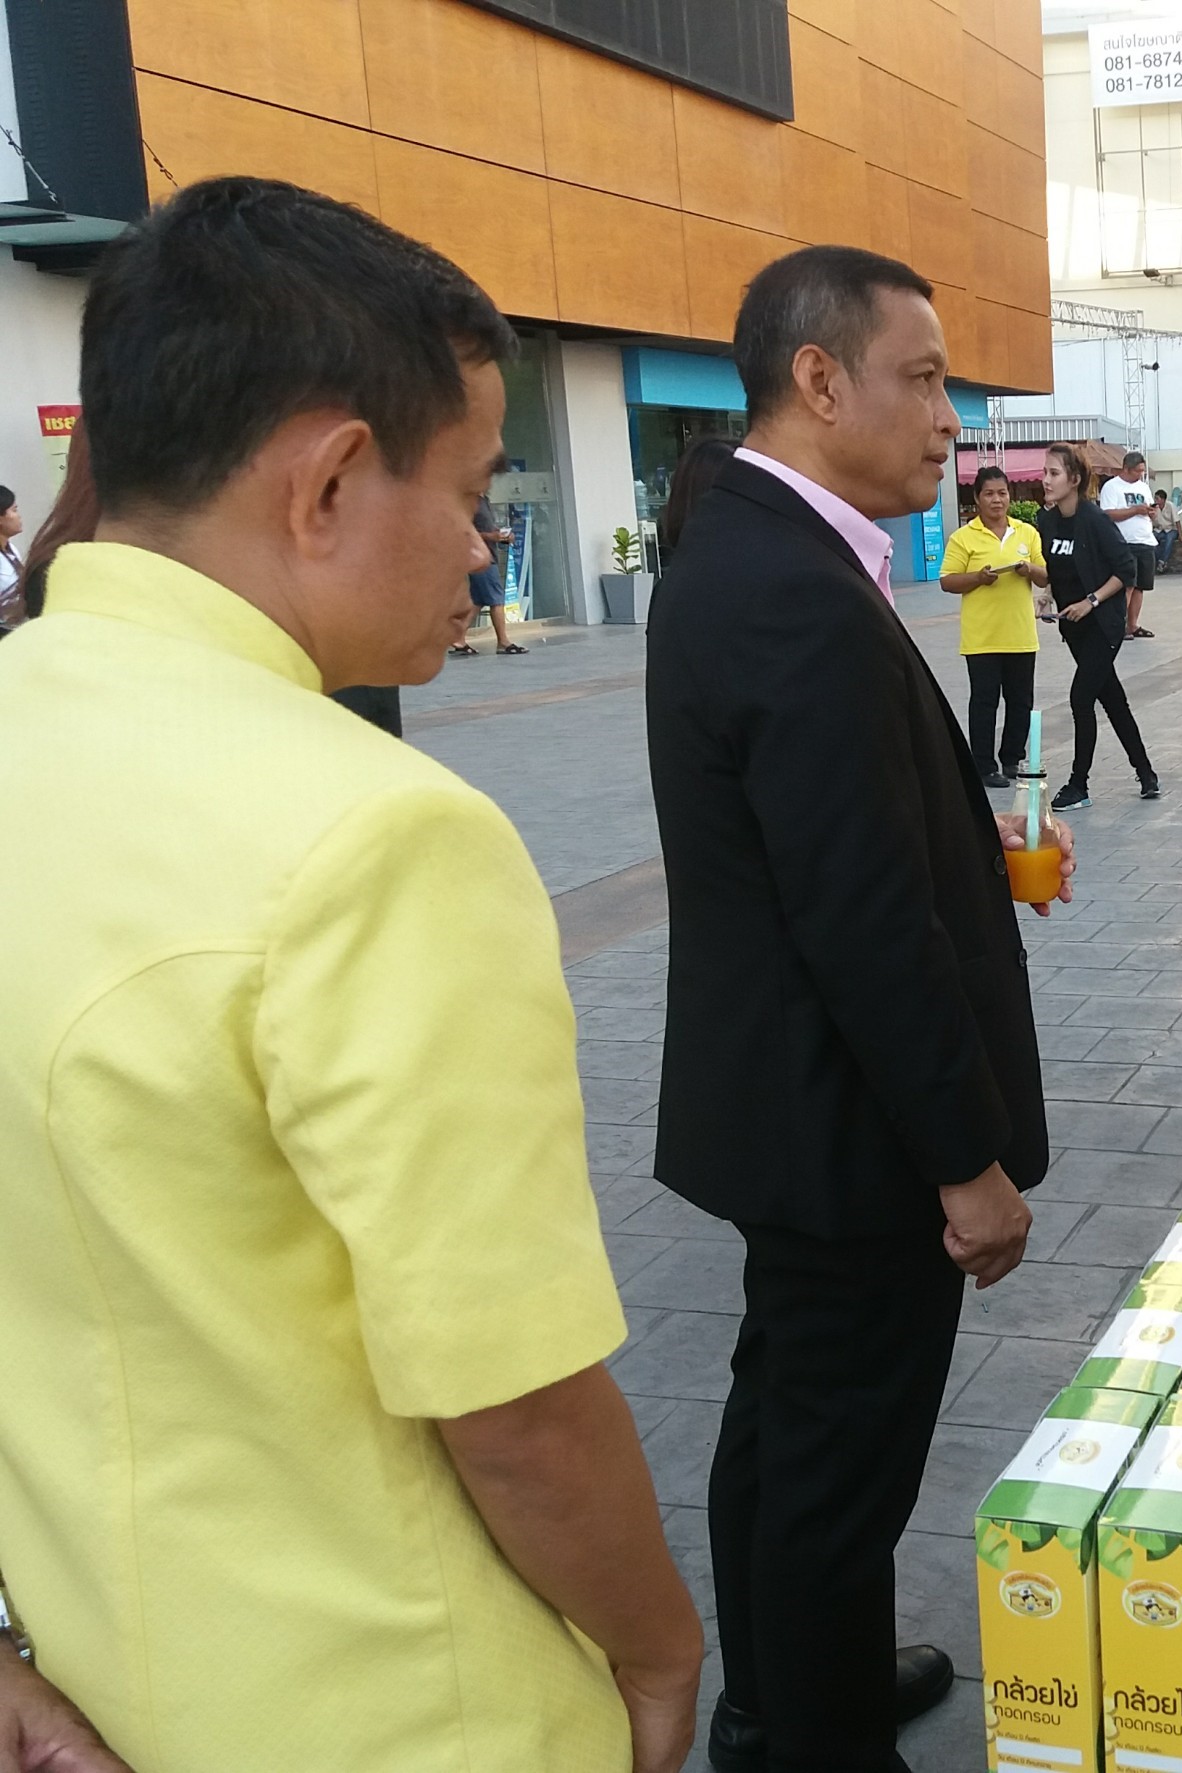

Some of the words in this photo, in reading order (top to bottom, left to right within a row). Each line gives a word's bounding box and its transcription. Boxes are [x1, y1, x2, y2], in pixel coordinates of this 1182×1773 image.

[993, 1675, 1078, 1709] กล้วยไข่
[993, 1704, 1061, 1726] ทอดกรอบ
[1113, 1715, 1182, 1736] ทอดกรอบ
